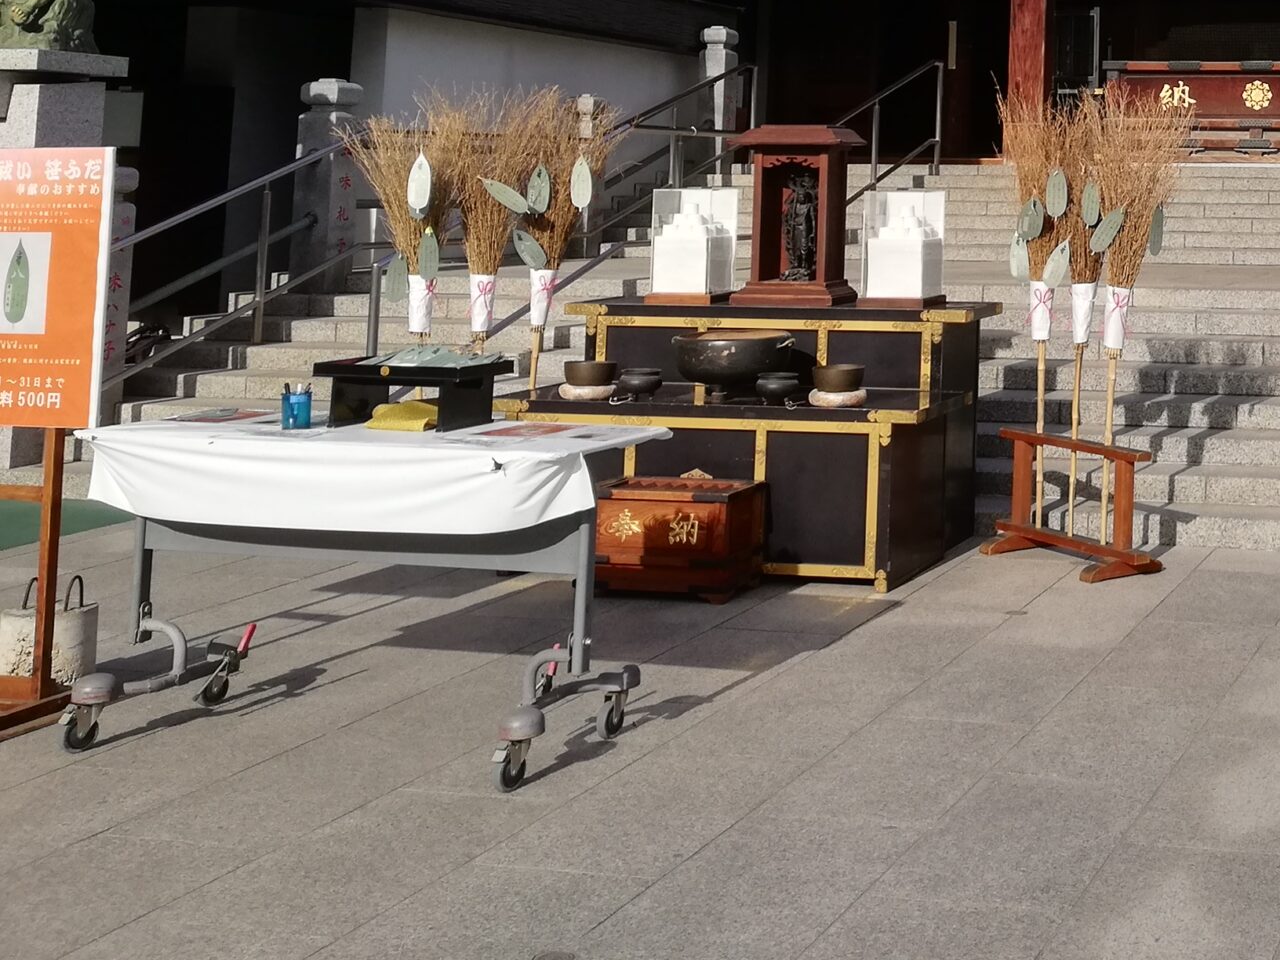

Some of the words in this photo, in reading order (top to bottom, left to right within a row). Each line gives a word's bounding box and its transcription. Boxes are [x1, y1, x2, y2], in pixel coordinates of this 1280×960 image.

[44, 158, 102, 181] 笹ふだ
[608, 508, 700, 545] 奉納
